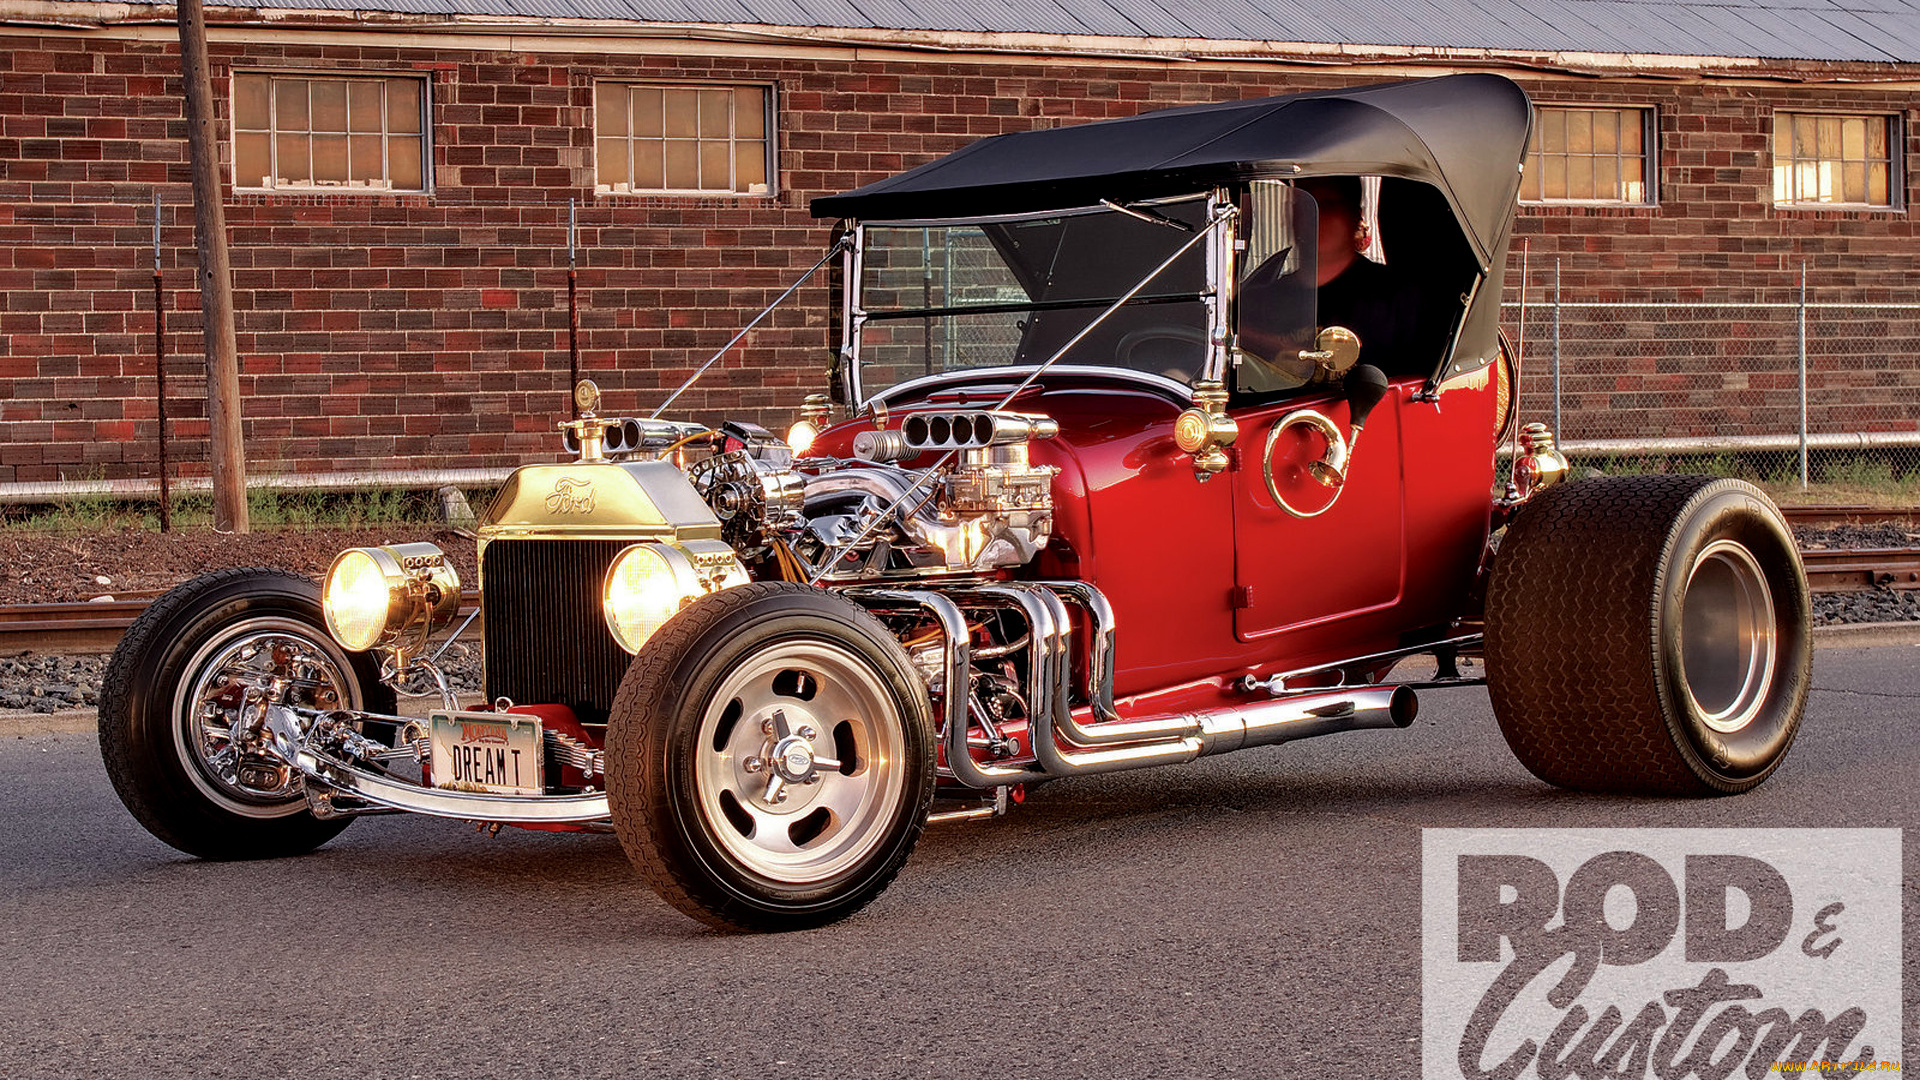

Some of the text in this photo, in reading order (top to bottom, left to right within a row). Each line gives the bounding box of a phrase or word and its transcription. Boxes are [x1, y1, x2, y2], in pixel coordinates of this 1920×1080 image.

[545, 476, 596, 515] Ford
[453, 745, 520, 786] DREAM T
